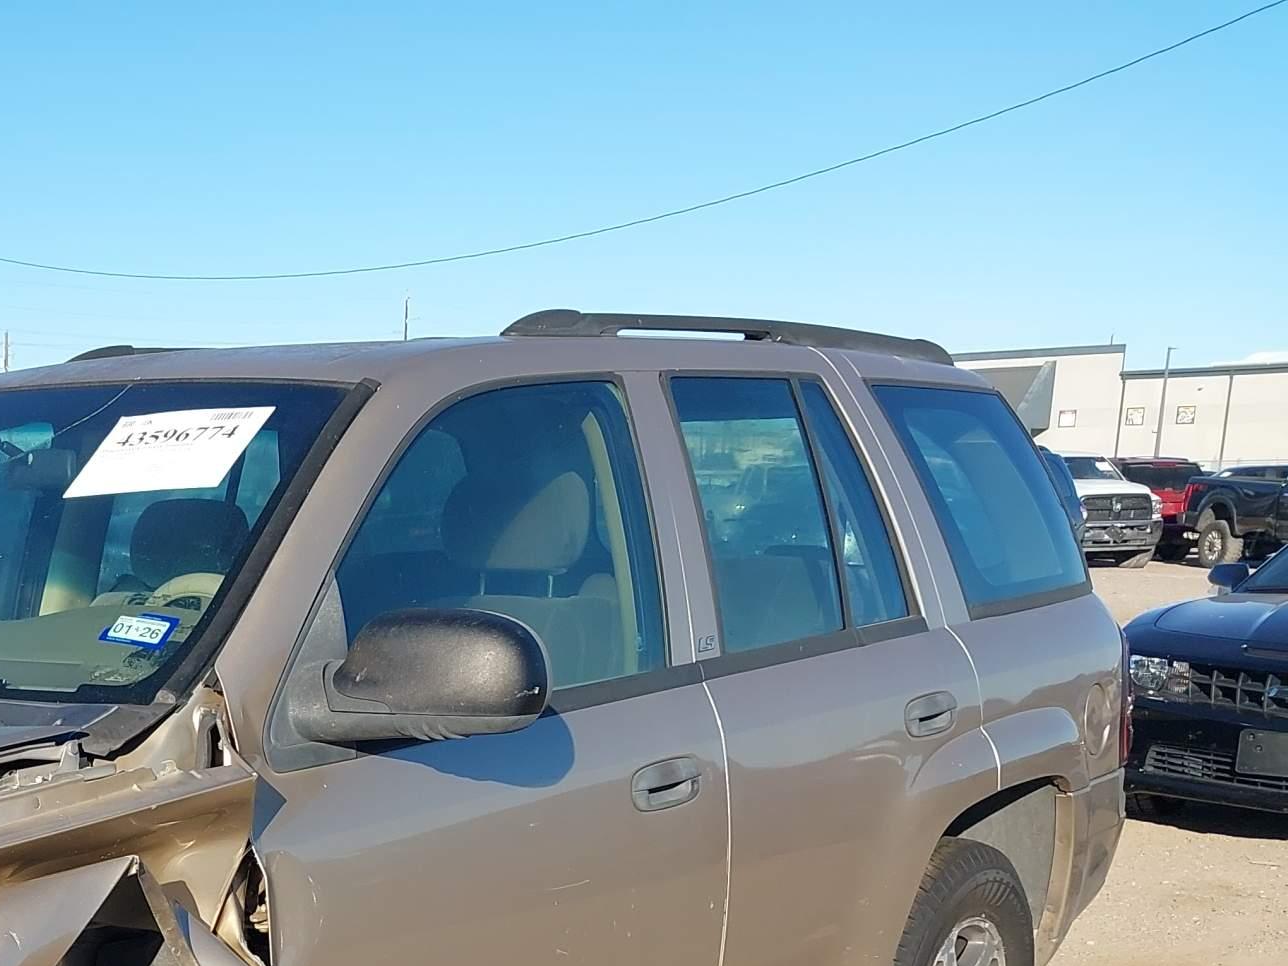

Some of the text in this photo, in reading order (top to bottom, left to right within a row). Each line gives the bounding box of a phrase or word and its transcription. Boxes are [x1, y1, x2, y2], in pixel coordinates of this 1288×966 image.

[116, 425, 240, 447] 43596774
[114, 623, 132, 635] 01
[140, 627, 161, 640] 26
